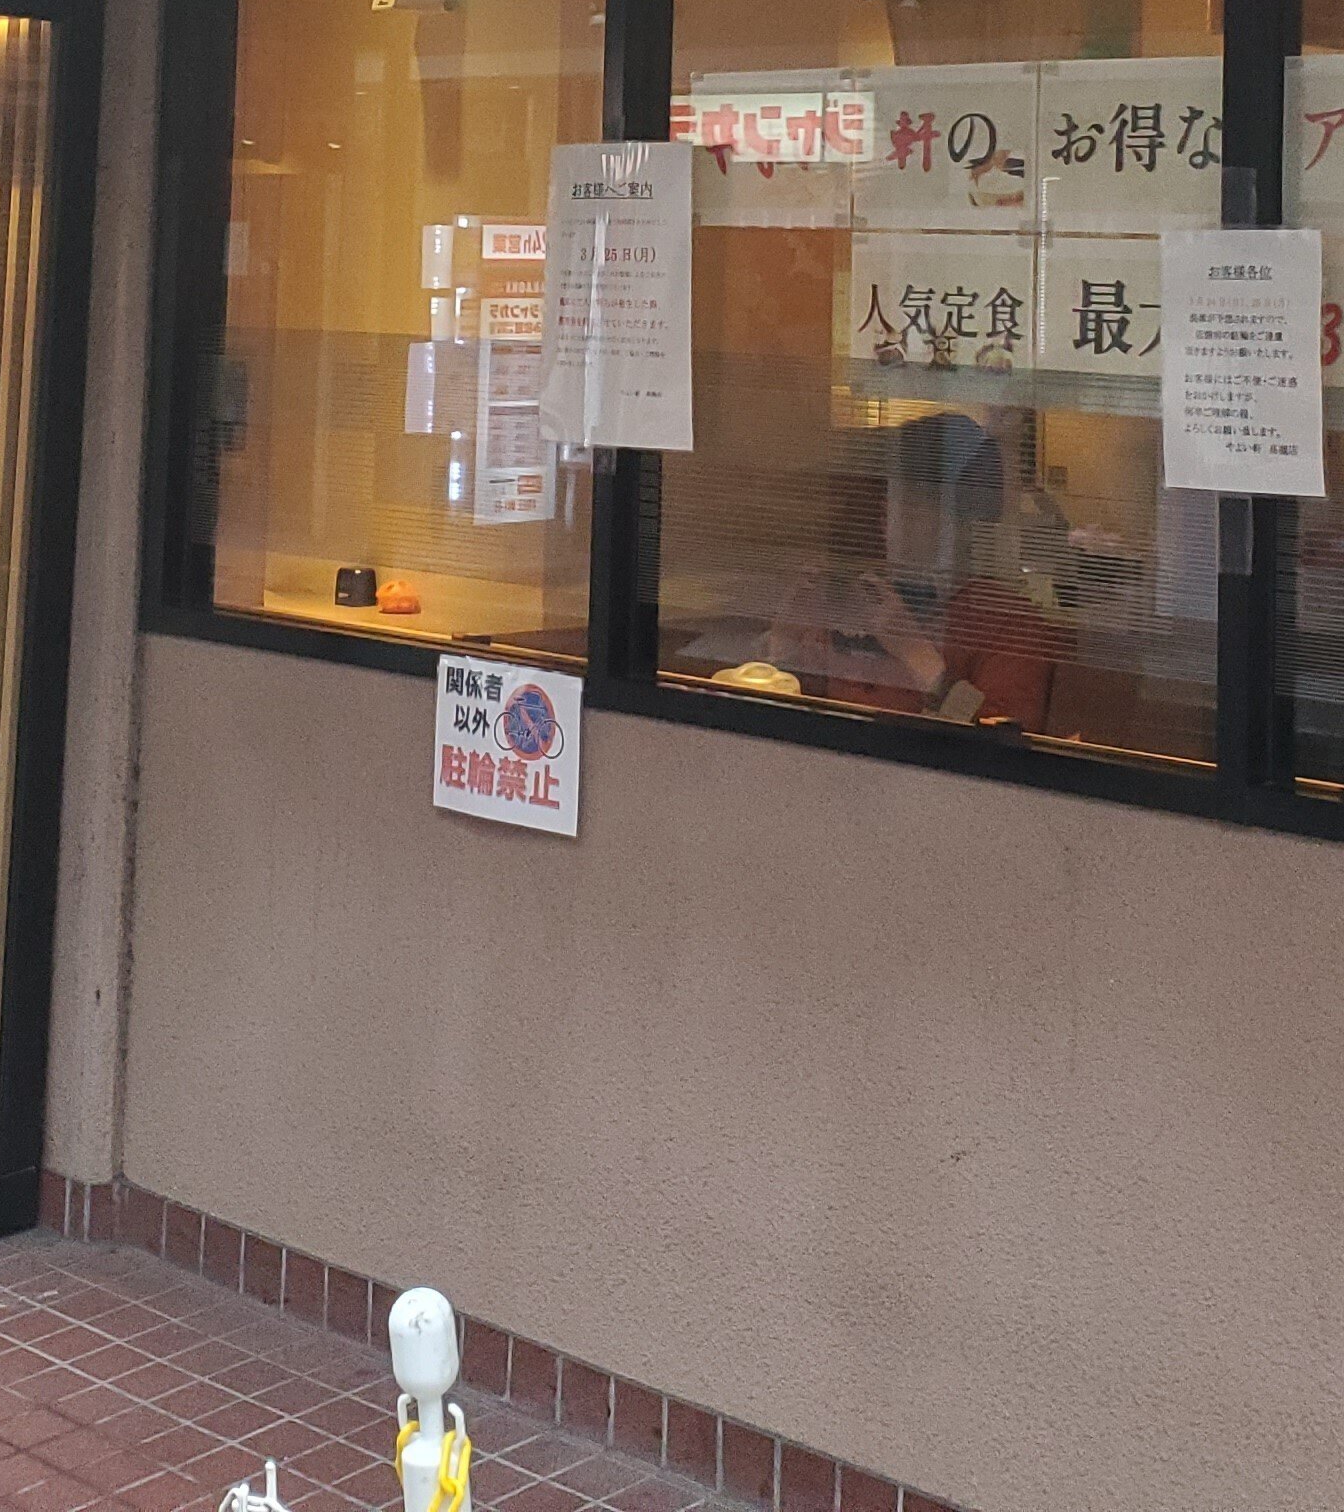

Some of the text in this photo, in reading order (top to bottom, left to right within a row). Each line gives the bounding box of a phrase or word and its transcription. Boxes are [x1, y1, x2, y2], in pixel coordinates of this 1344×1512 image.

[1051, 102, 1223, 173] お得な
[571, 180, 654, 199] お客様へご案内
[1207, 265, 1273, 281] お客様各位
[857, 282, 1025, 342] 人気定食
[445, 666, 504, 703] 関係者
[453, 704, 491, 739] 以外
[439, 743, 561, 811] 駐輪禁止
